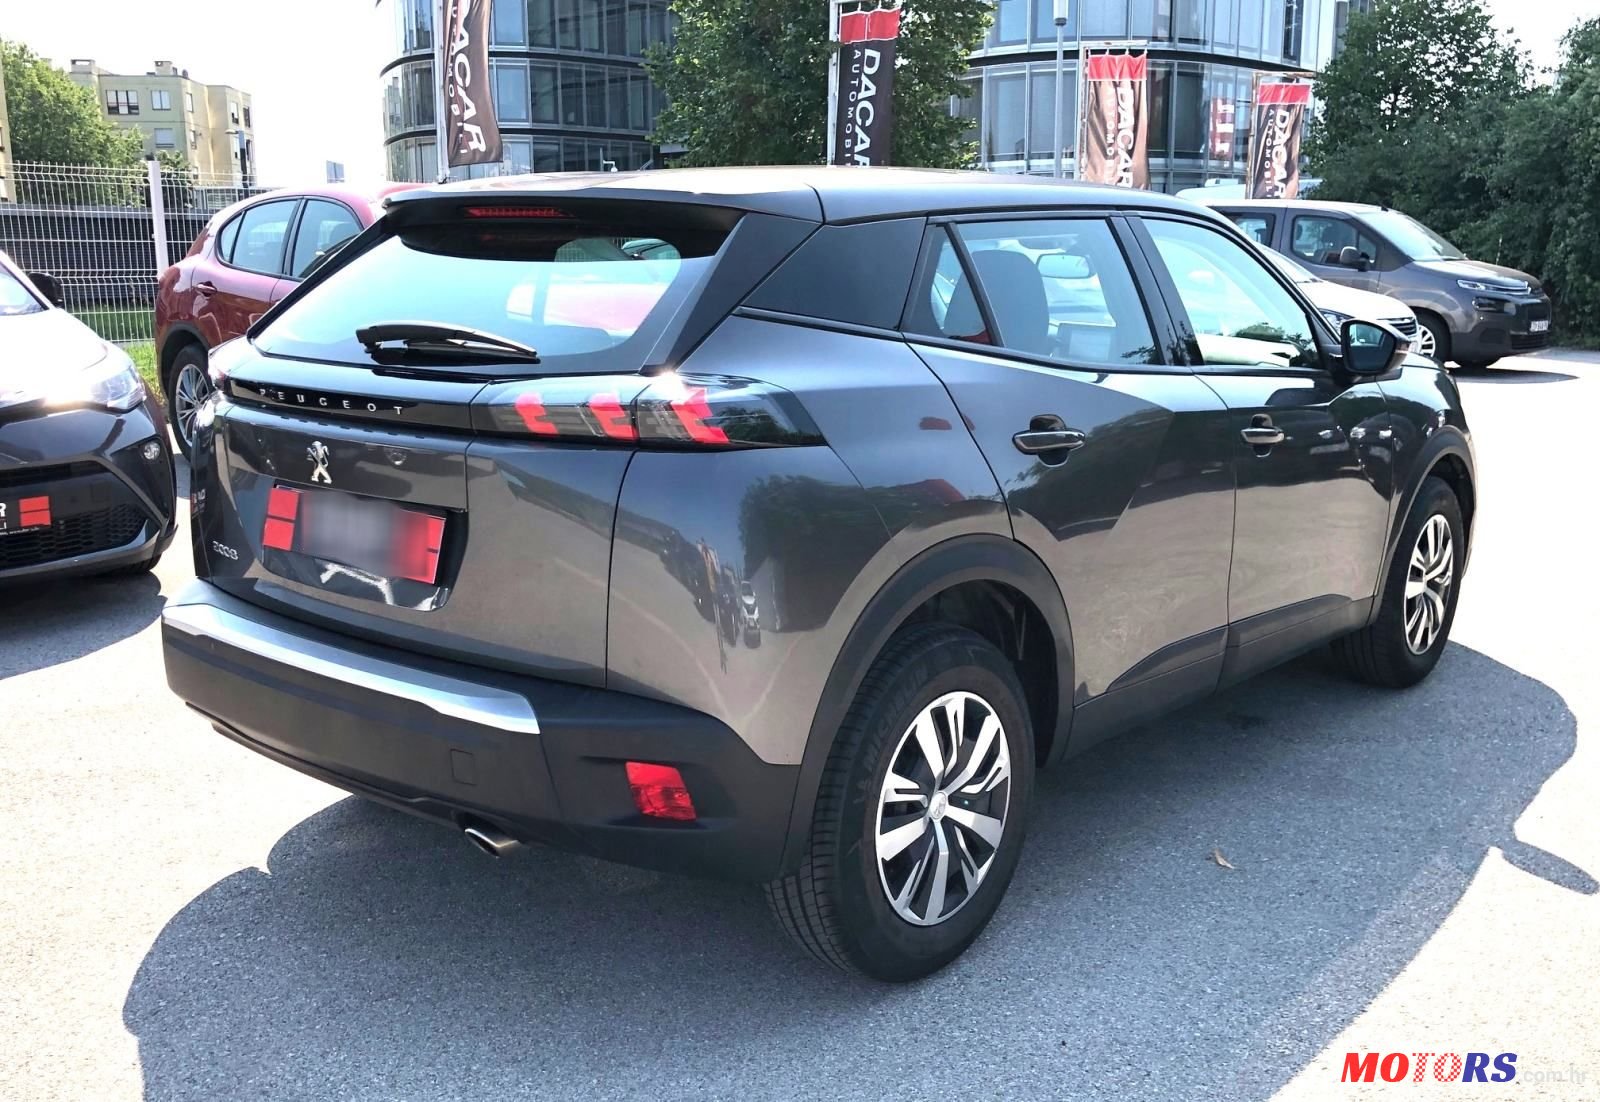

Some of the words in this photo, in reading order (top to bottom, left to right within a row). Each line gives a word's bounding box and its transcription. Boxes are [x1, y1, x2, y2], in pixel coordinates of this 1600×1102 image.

[1272, 108, 1291, 199] DACAR
[259, 388, 403, 415] PEUGEOT
[213, 540, 239, 560] 2008
